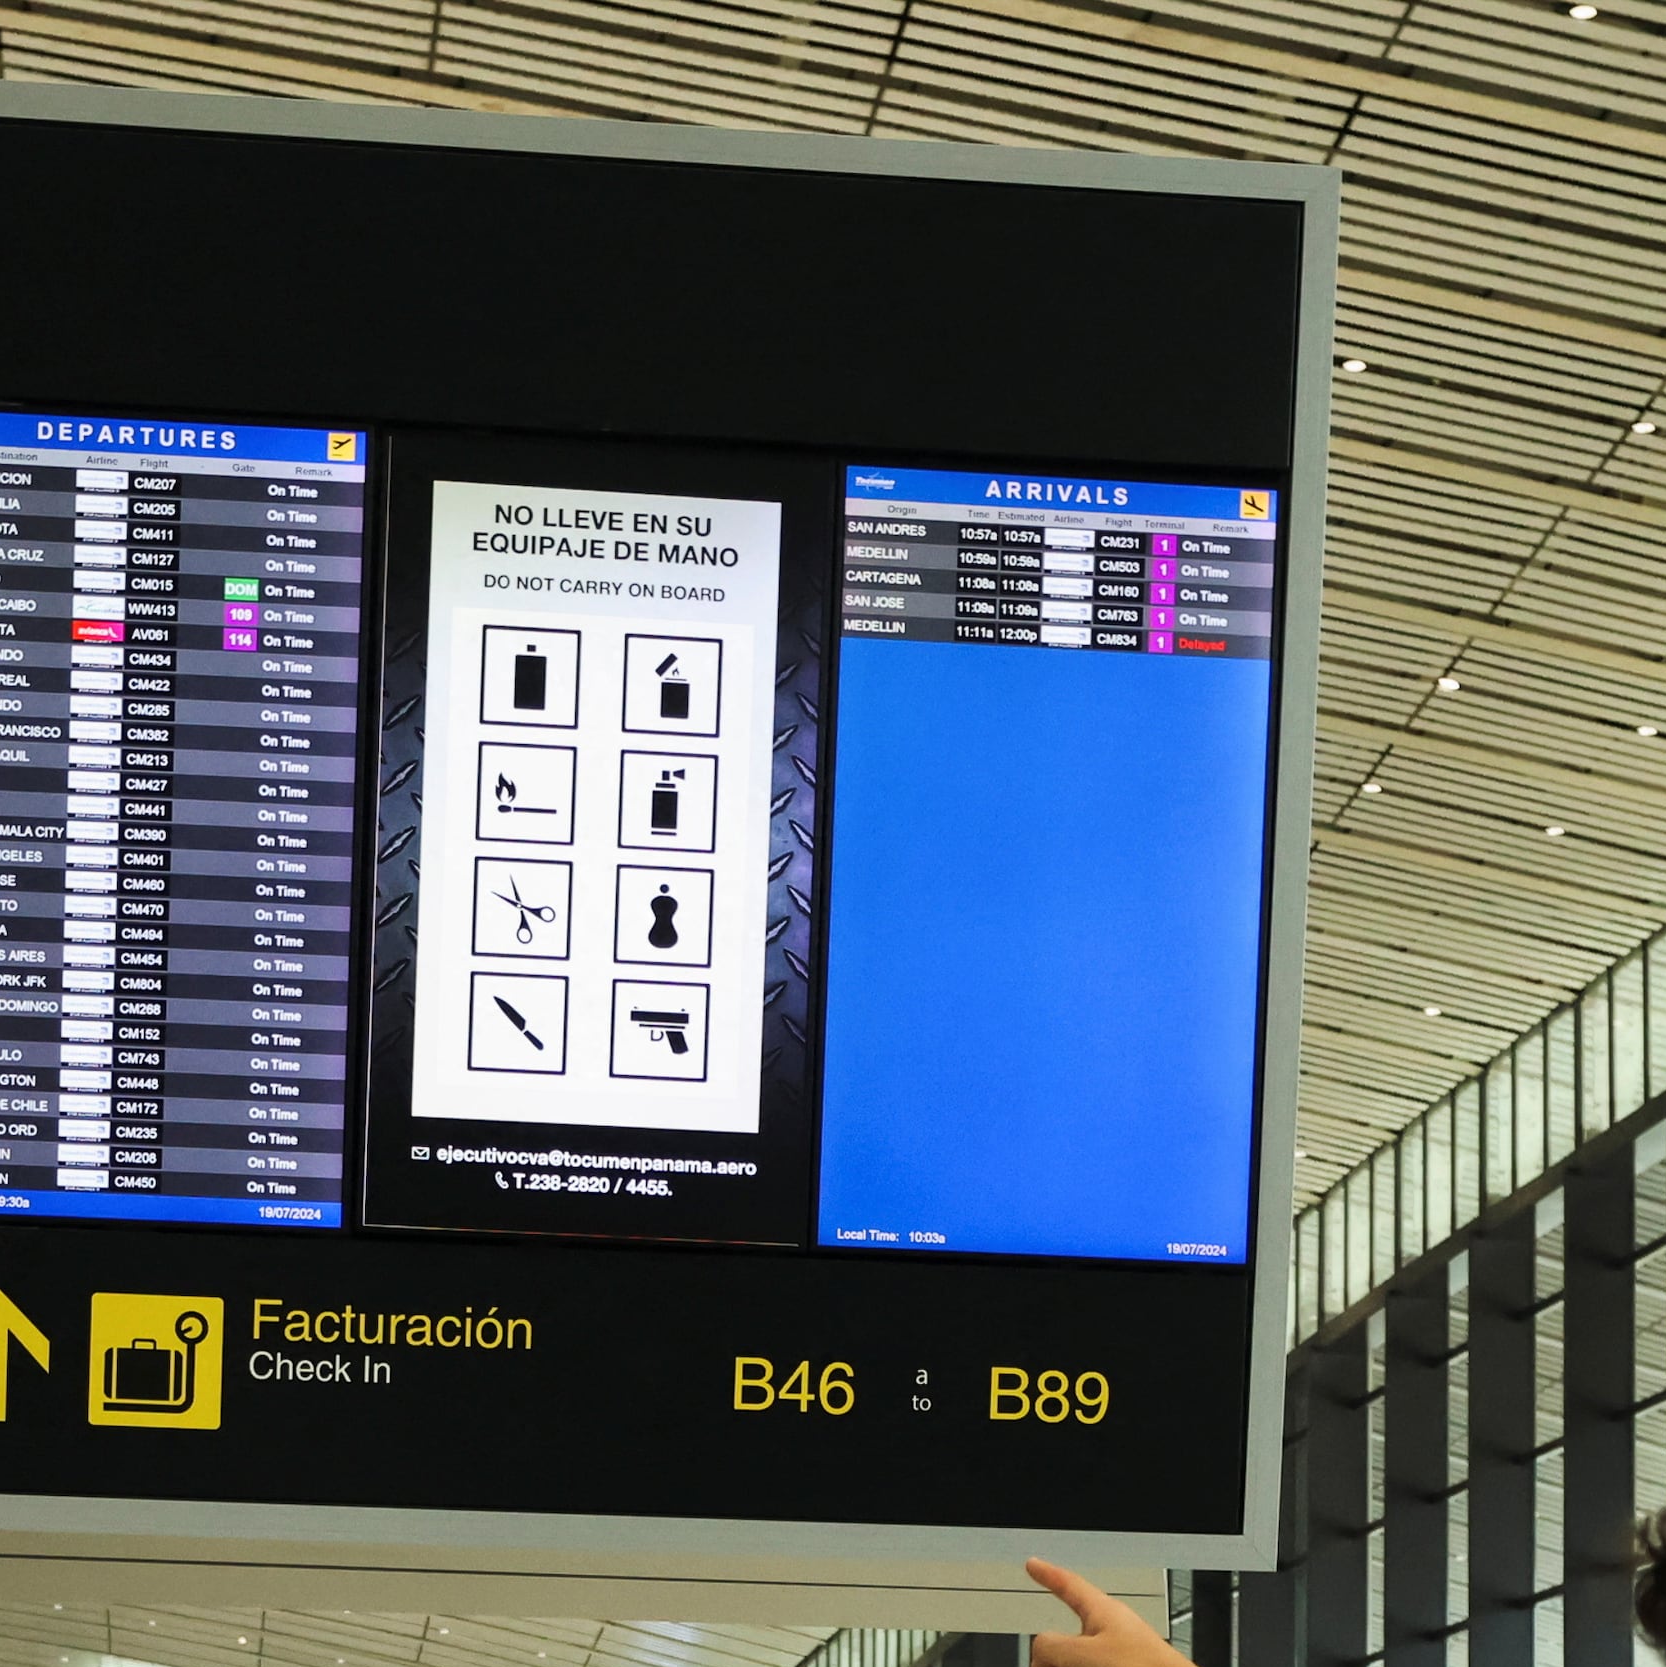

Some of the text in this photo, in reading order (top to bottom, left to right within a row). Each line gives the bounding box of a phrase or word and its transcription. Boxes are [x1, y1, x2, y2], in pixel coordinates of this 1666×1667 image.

[37, 421, 236, 450] DEPARTURES
[134, 476, 175, 490] CM207
[267, 485, 286, 498] On
[289, 486, 318, 499] Time
[986, 480, 1129, 506] ARRIVALS
[495, 504, 712, 537] NO LLEVE EN SU
[473, 532, 738, 567] EQUIPAJE DE MANO
[847, 522, 1231, 556] SAN ANDRES 10:57a 10:57a CM231 1 On Time
[846, 546, 1230, 580] MEDELLIN 10:59a 10:59a CM503 1 On Time
[484, 574, 725, 602] DO NOT CARRY ON BOARD
[846, 570, 1229, 605] CARTAGENA 11:08a 11:08a CM160 1 On Time
[845, 594, 1228, 629] SAN JOSE 11:09a 11:09a CM763 1 On Time
[843, 619, 1225, 654] MEDELLIN 11:11a 12:00p CM834 1 Delayed
[436, 1146, 757, 1176] ejecutivocva@tocumenpanama.aero
[513, 1173, 673, 1197] T.238-2820 / 4455.
[836, 1228, 1228, 1259] Local Time: 10:03a 19/07/2024
[252, 1299, 534, 1350] Facturación
[248, 1351, 391, 1384] Check In
[916, 1368, 928, 1385] a
[733, 1356, 1110, 1425] B46 B89
[912, 1394, 932, 1412] to
